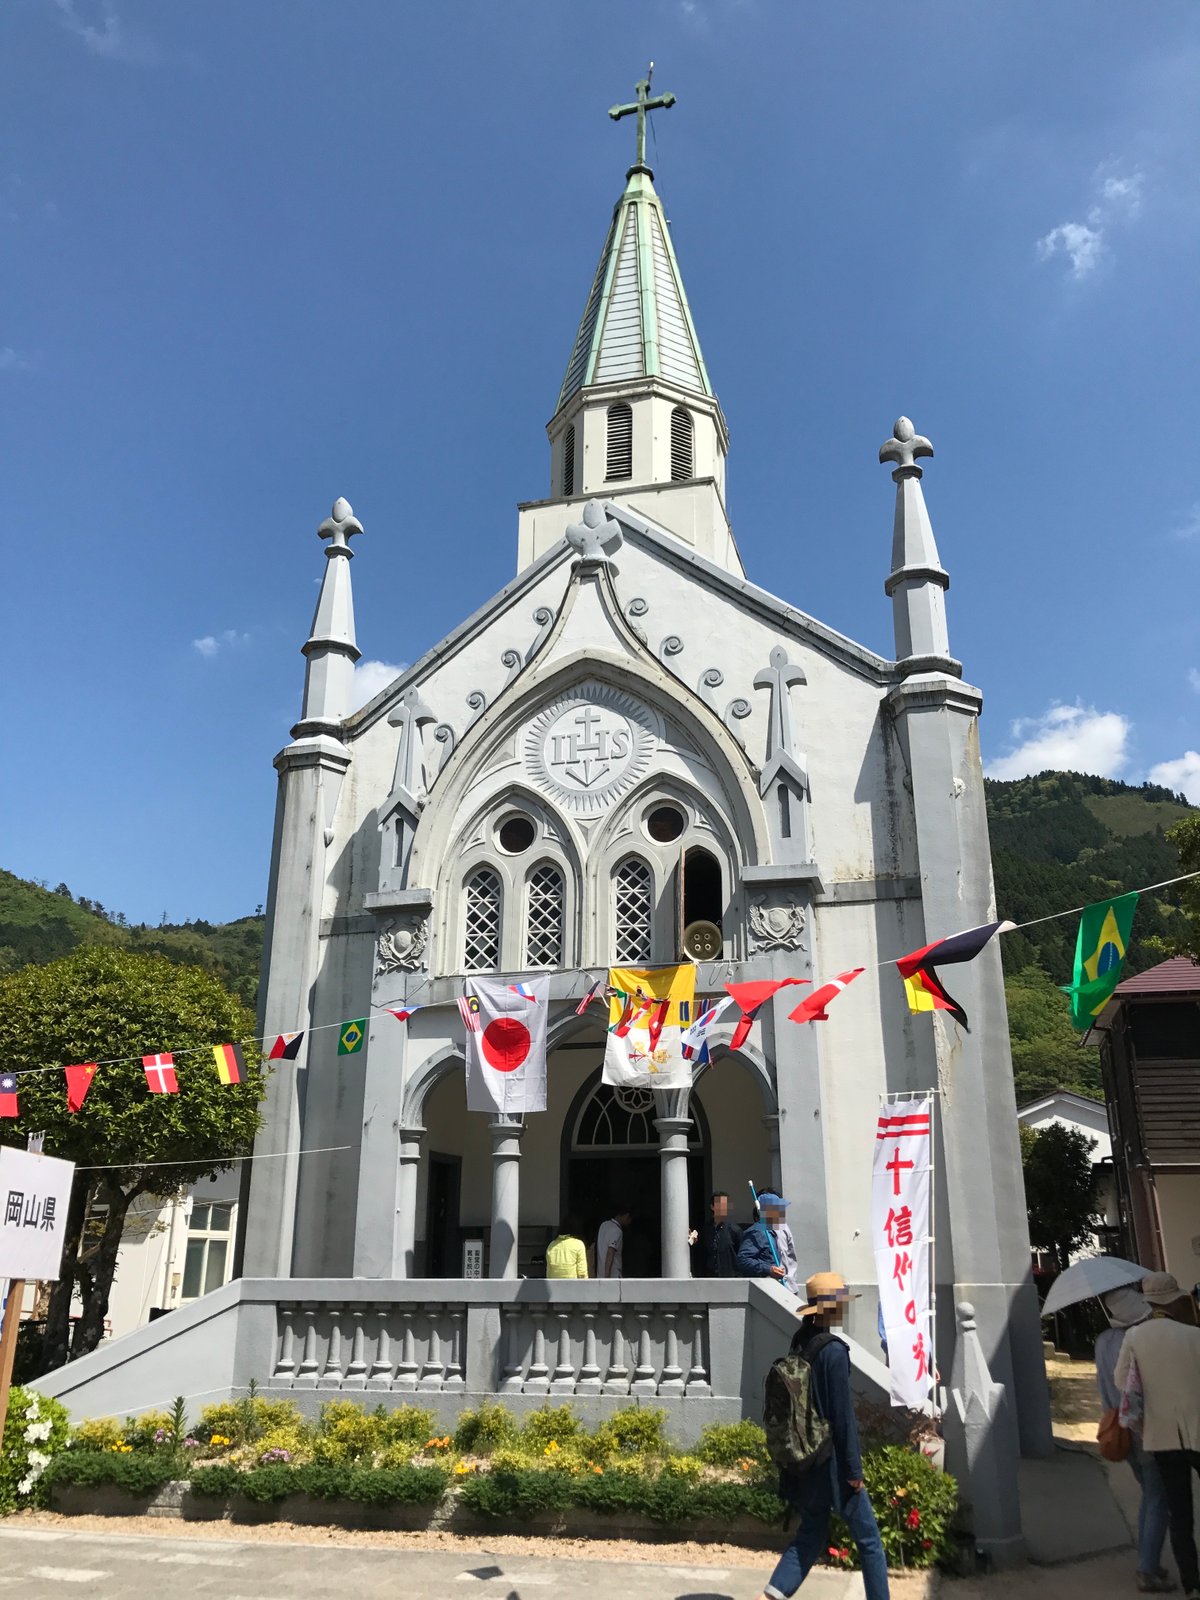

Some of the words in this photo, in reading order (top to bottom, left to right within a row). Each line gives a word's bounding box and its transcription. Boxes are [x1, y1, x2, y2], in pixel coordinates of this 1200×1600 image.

[551, 729, 629, 765] IHS
[4, 1190, 57, 1232] 岡山県
